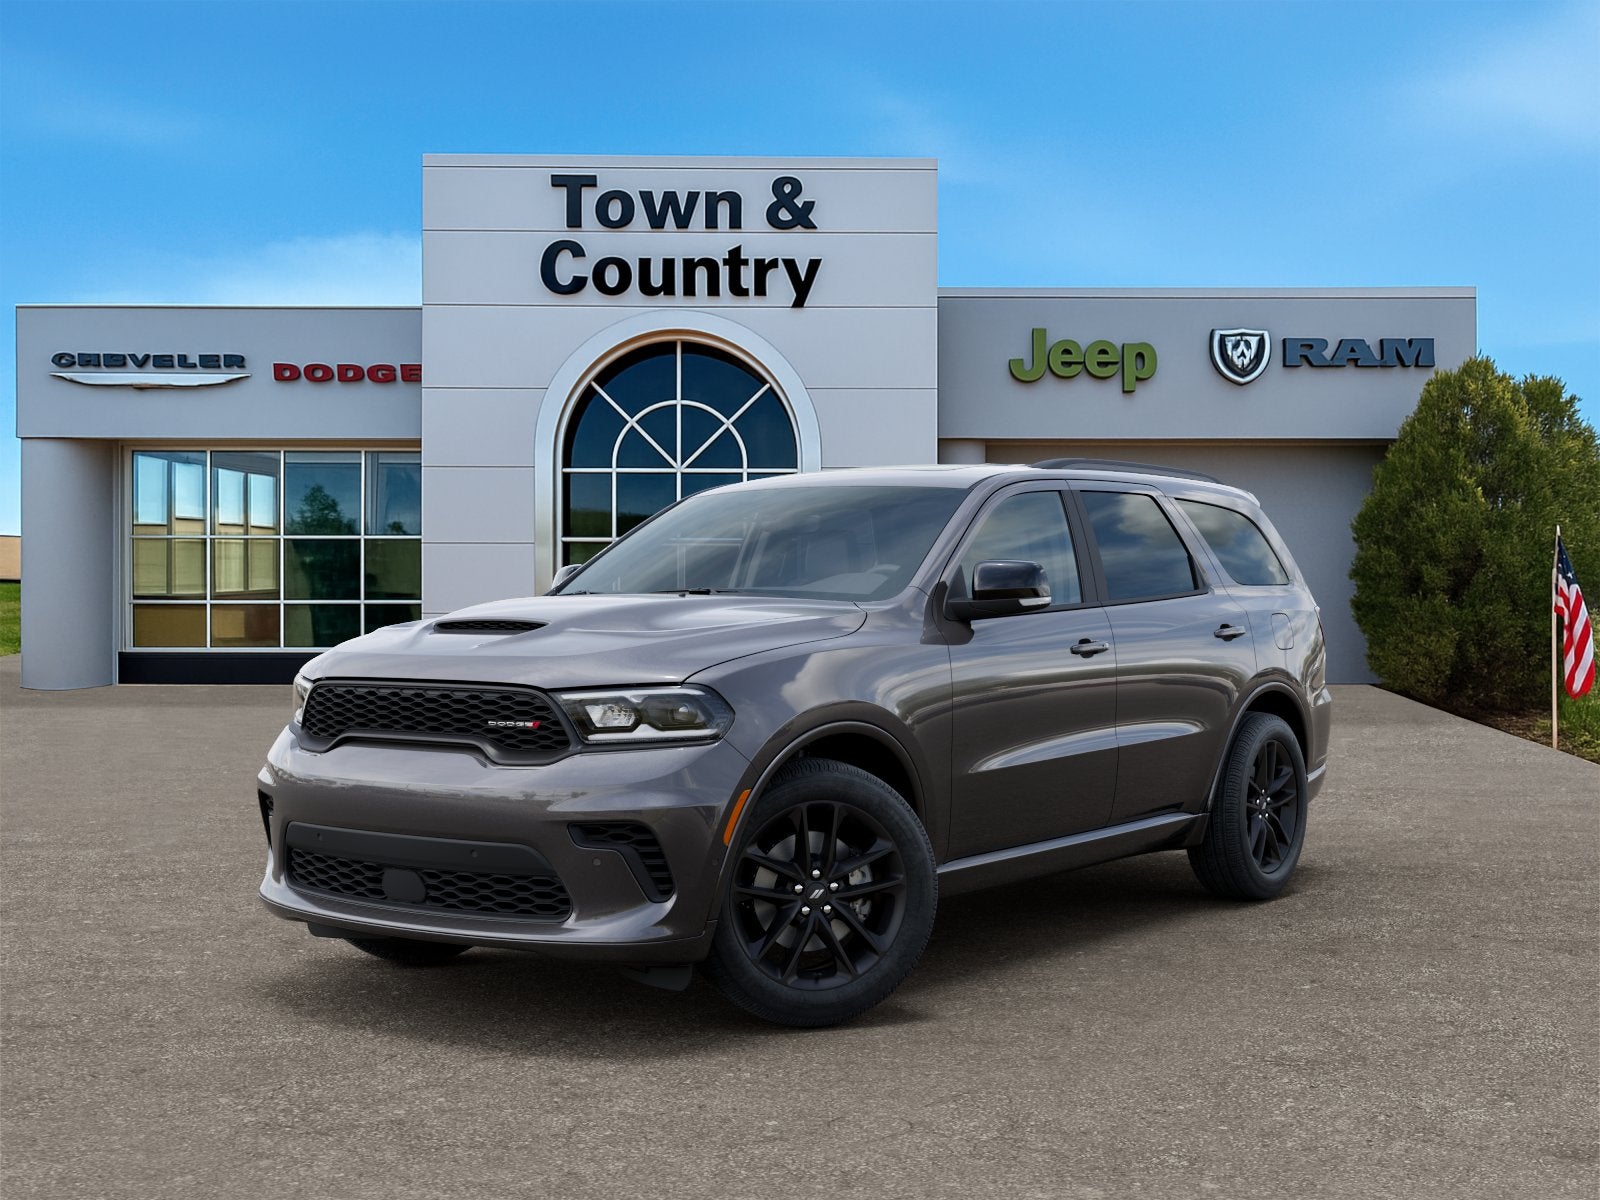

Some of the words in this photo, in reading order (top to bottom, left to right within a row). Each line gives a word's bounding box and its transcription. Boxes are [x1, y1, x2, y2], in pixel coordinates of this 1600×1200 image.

[550, 174, 742, 229] Town
[766, 176, 818, 230] &
[540, 239, 822, 308] Country
[273, 363, 422, 382] DODGE
[1009, 328, 1157, 393] Jeep
[1283, 338, 1434, 368] RAM
